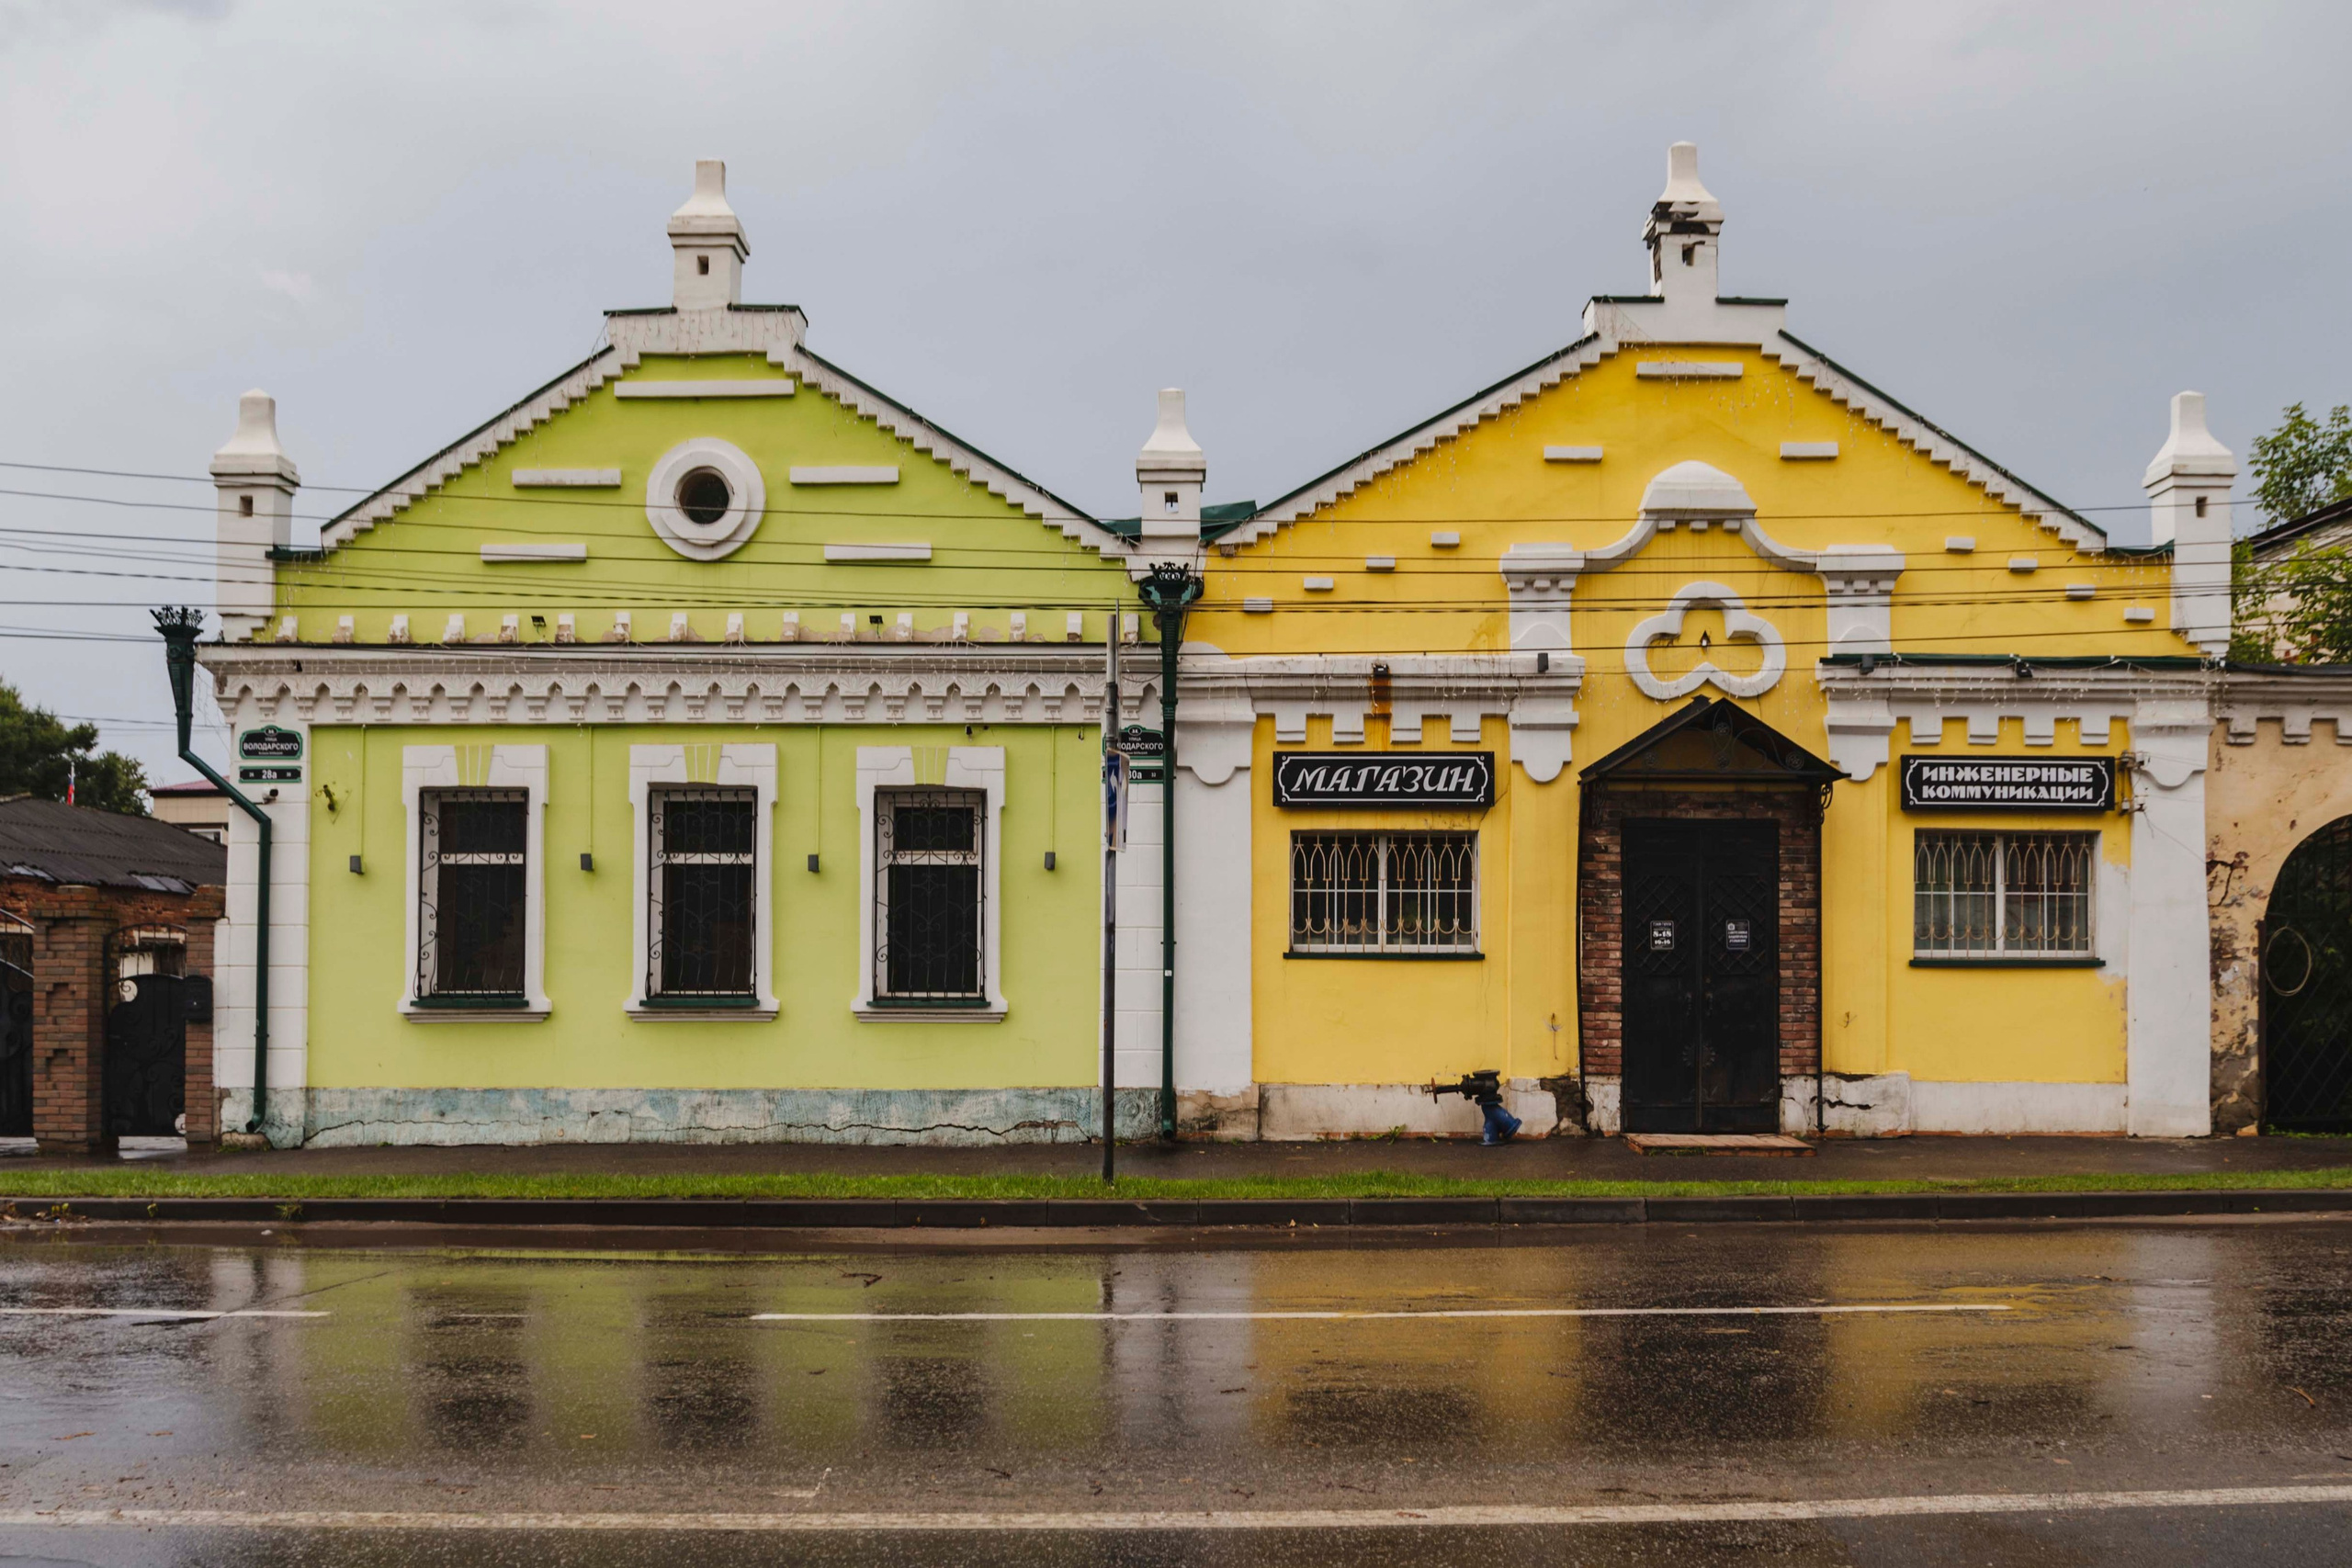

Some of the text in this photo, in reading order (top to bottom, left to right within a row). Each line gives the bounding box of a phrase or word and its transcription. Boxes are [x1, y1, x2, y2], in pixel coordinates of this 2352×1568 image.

[243, 742, 300, 751] ВОЛОДАРСКОГО
[1118, 742, 1164, 751] ОДАРСКОГО
[262, 769, 277, 779] 28а
[1290, 764, 1476, 793] МАГАЗИН
[1921, 765, 2094, 784] ИНЖЕНЕРНЫЕ
[1921, 784, 2094, 803] КОММУНИКАЦИИ
